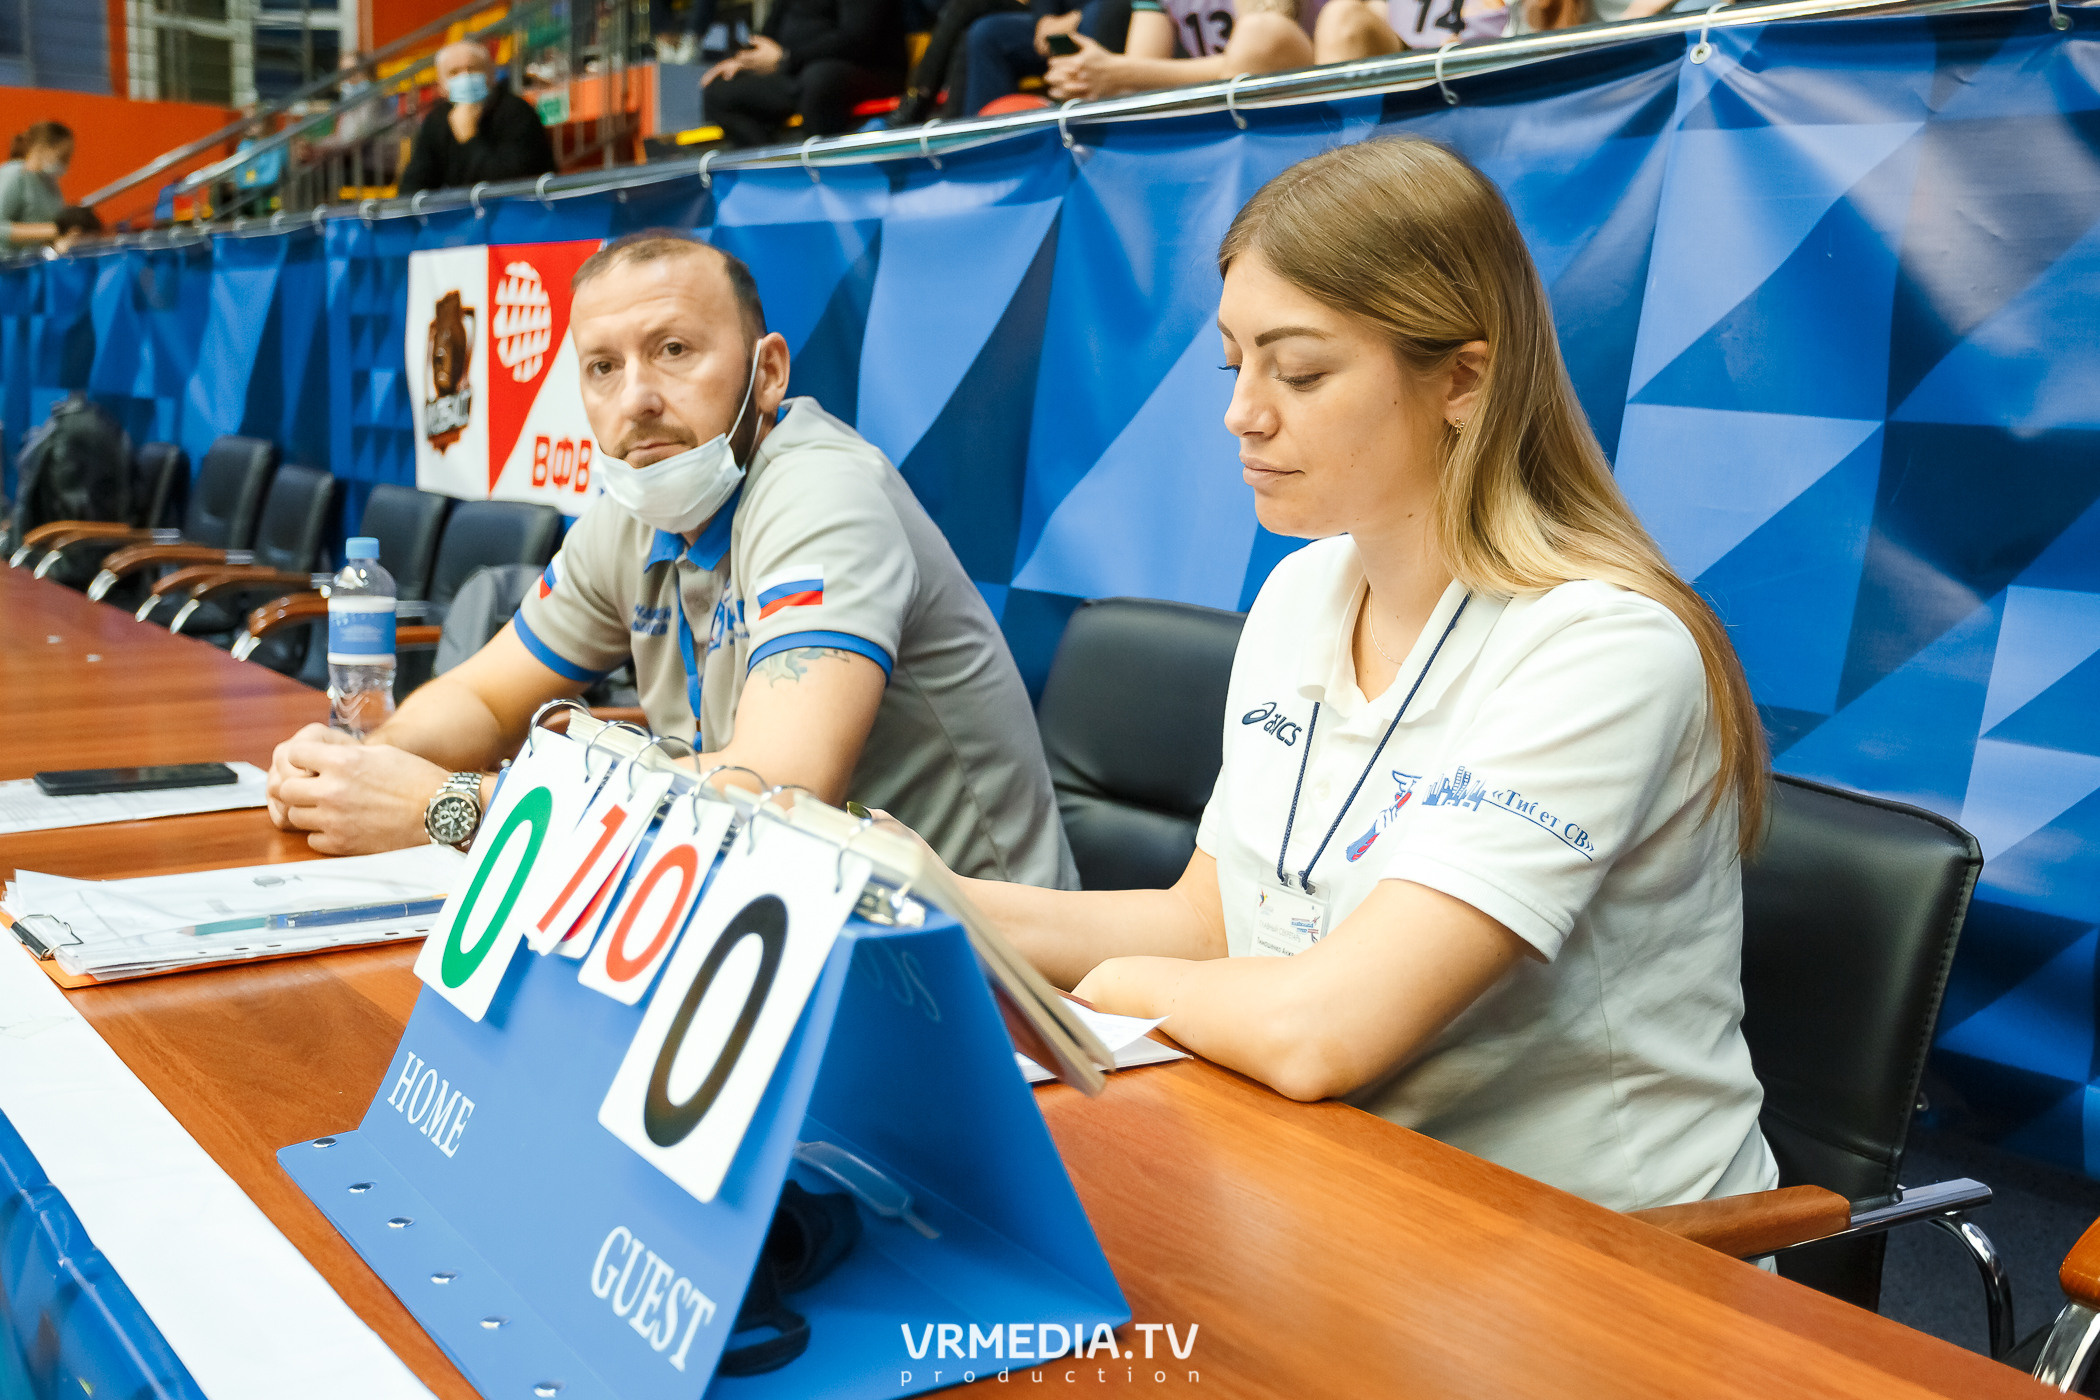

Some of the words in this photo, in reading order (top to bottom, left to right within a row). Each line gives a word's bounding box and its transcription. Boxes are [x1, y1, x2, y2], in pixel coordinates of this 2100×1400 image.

[1185, 10, 1234, 57] 13
[532, 435, 592, 493] ВФВ
[441, 785, 553, 990] 0
[536, 804, 628, 934] 1
[1564, 822, 1595, 852] СВ»
[606, 843, 699, 982] 0
[643, 894, 788, 1148] 0
[387, 1051, 476, 1159] HOME
[591, 1225, 717, 1373] GUEST
